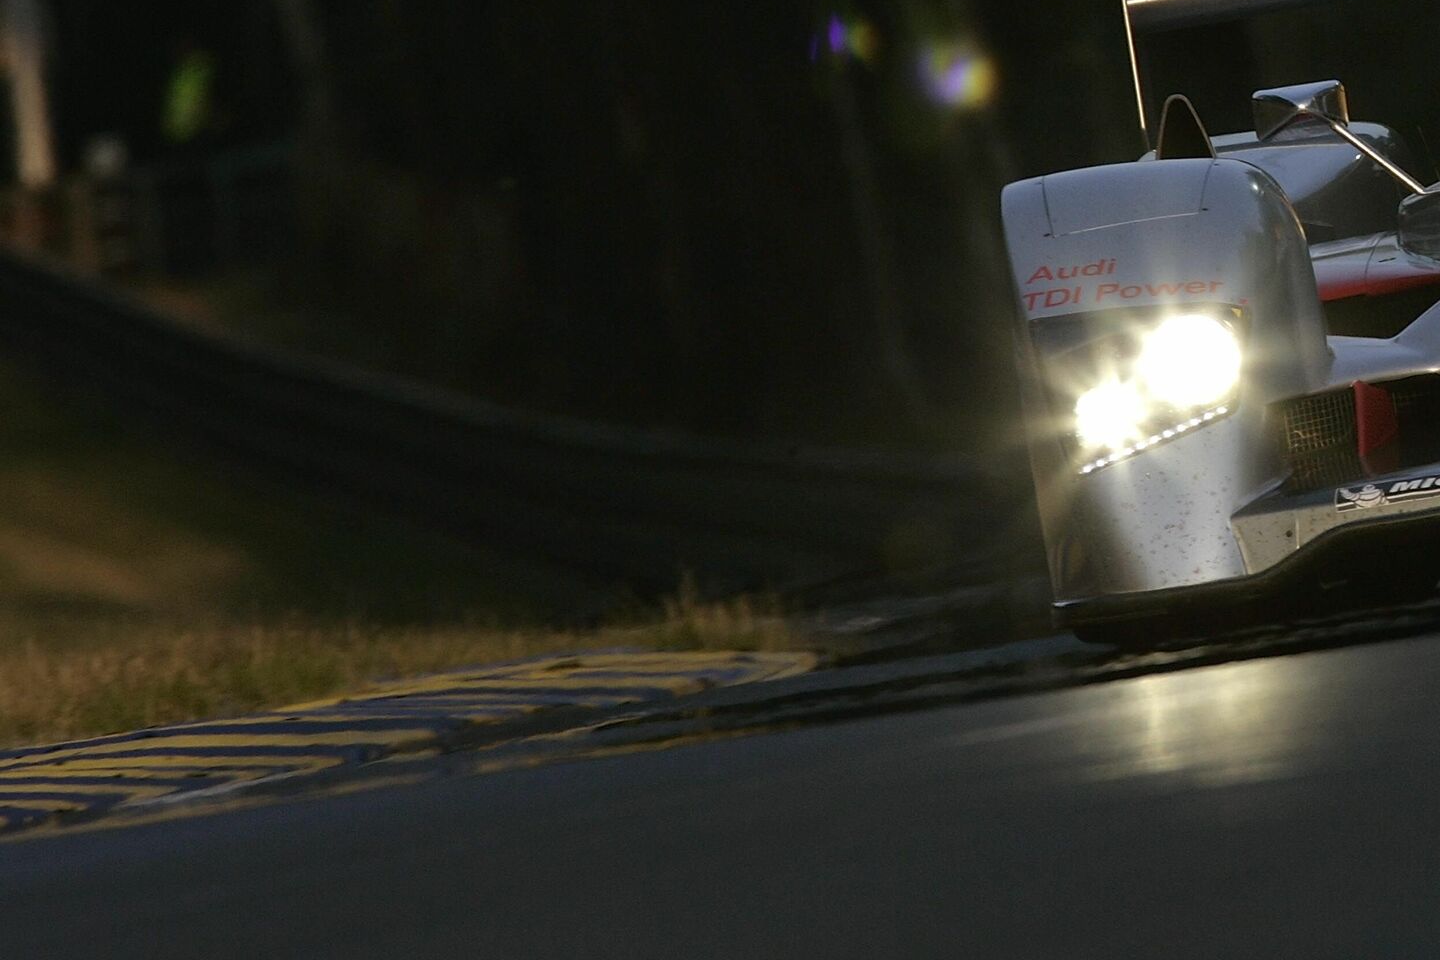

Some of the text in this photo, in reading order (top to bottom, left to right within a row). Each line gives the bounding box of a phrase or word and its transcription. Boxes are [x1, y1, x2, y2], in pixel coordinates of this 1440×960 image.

[1026, 258, 1117, 284] Audi
[1022, 280, 1223, 311] TDI Power
